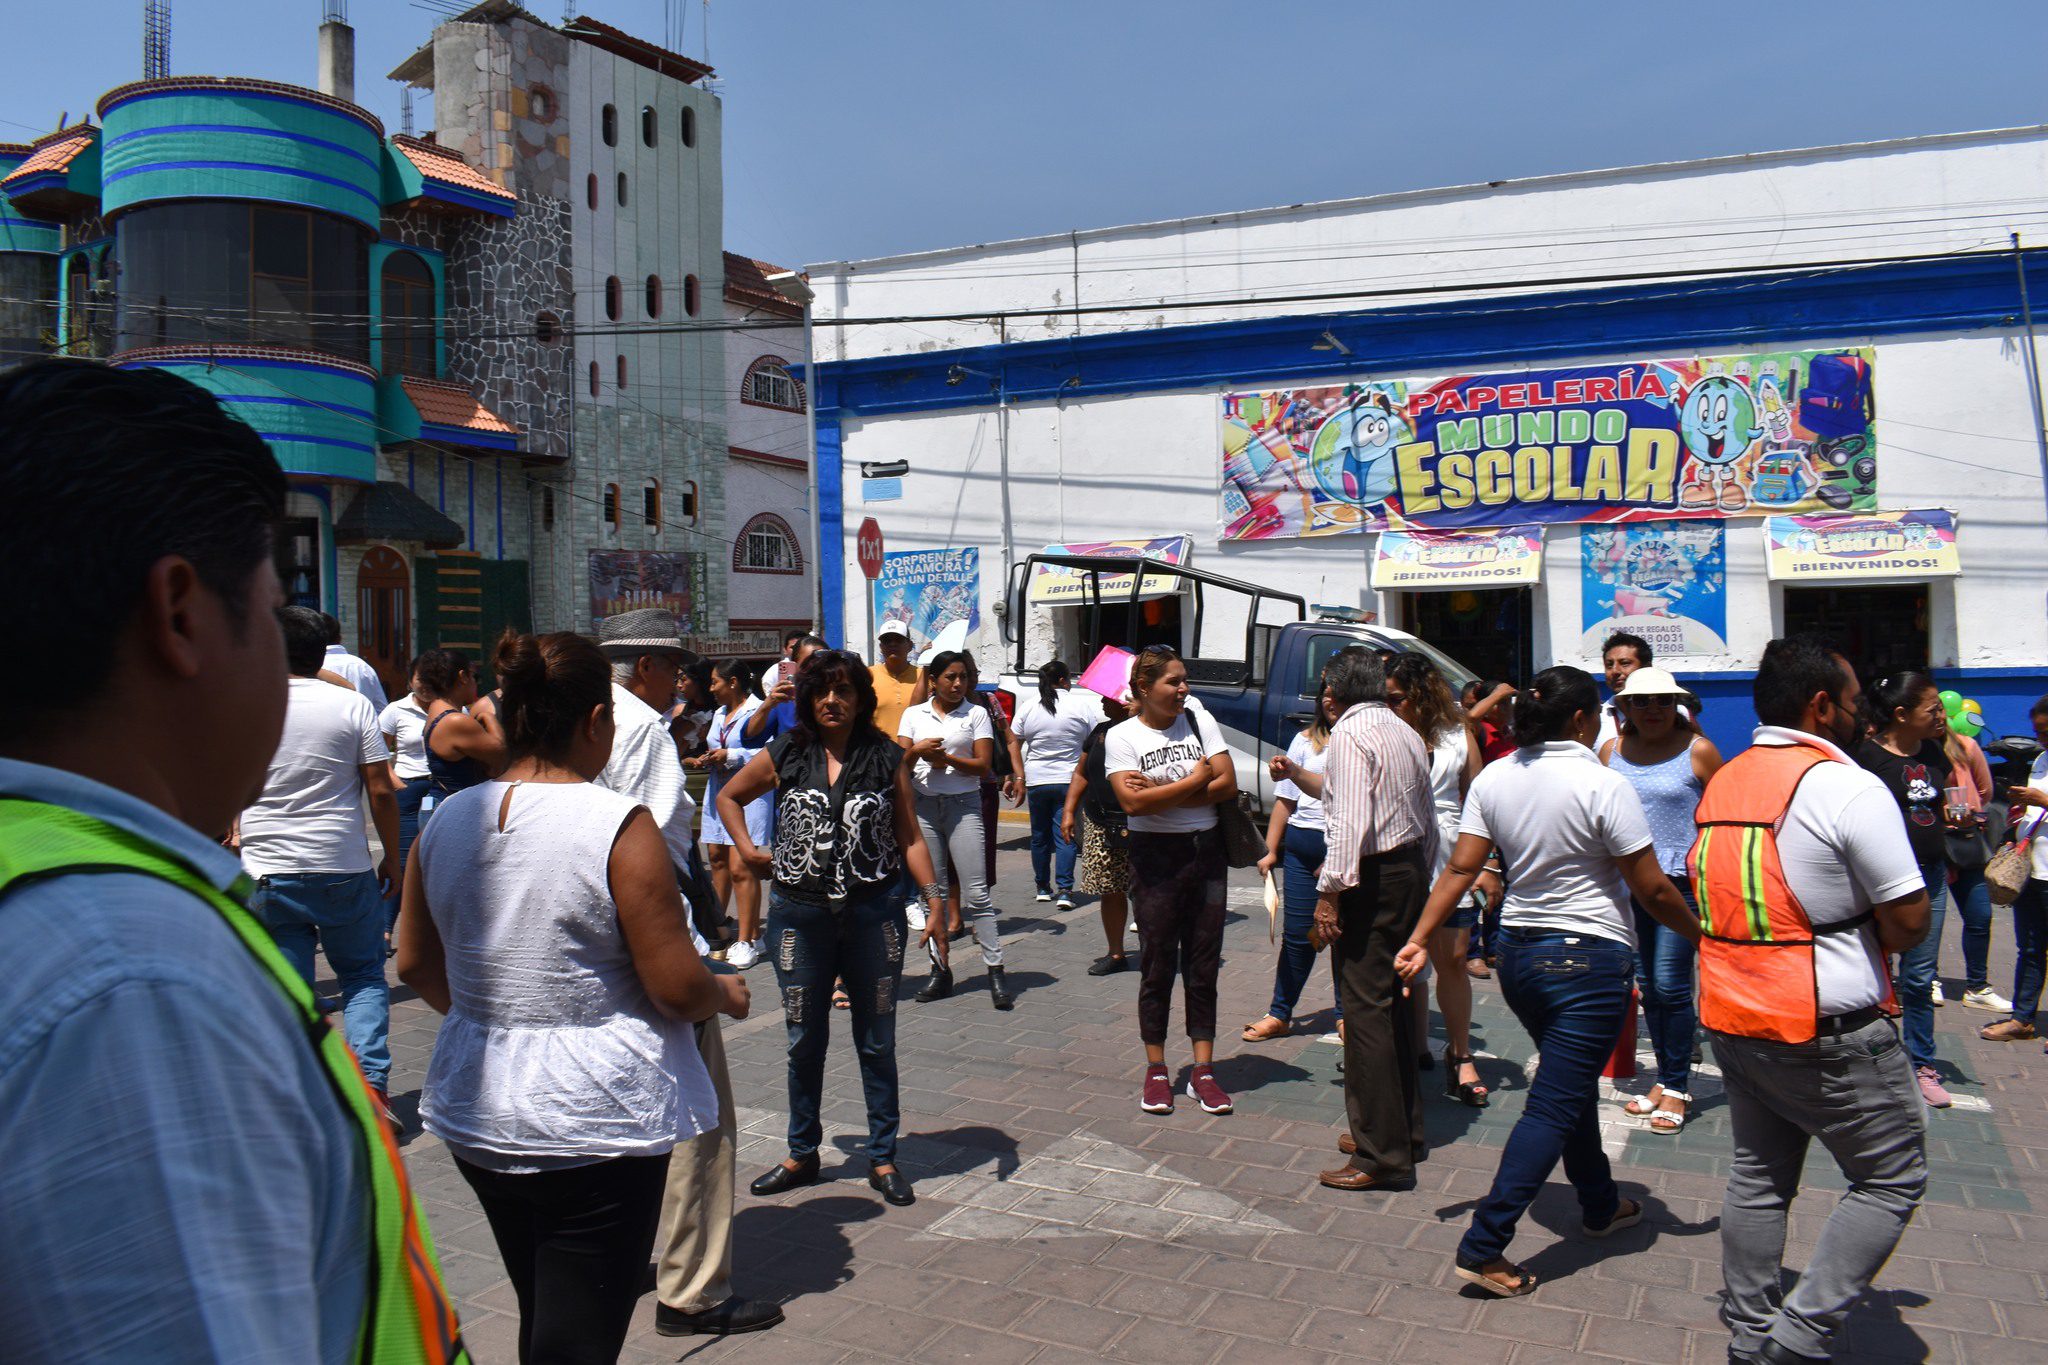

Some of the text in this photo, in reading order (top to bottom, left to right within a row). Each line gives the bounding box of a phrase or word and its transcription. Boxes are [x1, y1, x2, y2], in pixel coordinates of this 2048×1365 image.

[1407, 367, 1669, 417] PAPELERÍA
[1437, 408, 1628, 454] MUNDO
[1395, 427, 1680, 516] ESCOLAR
[1815, 533, 1905, 554] ESCOLAR
[885, 551, 962, 569] SORPRENDE
[1793, 559, 1939, 572] ¡BIENVENIDOS!
[882, 572, 974, 589] CON UN DETALLE
[1393, 567, 1522, 581] ¡BIENVENIDOS!
[1646, 625, 1682, 633] REGALOS
[1656, 633, 1684, 643] 0031
